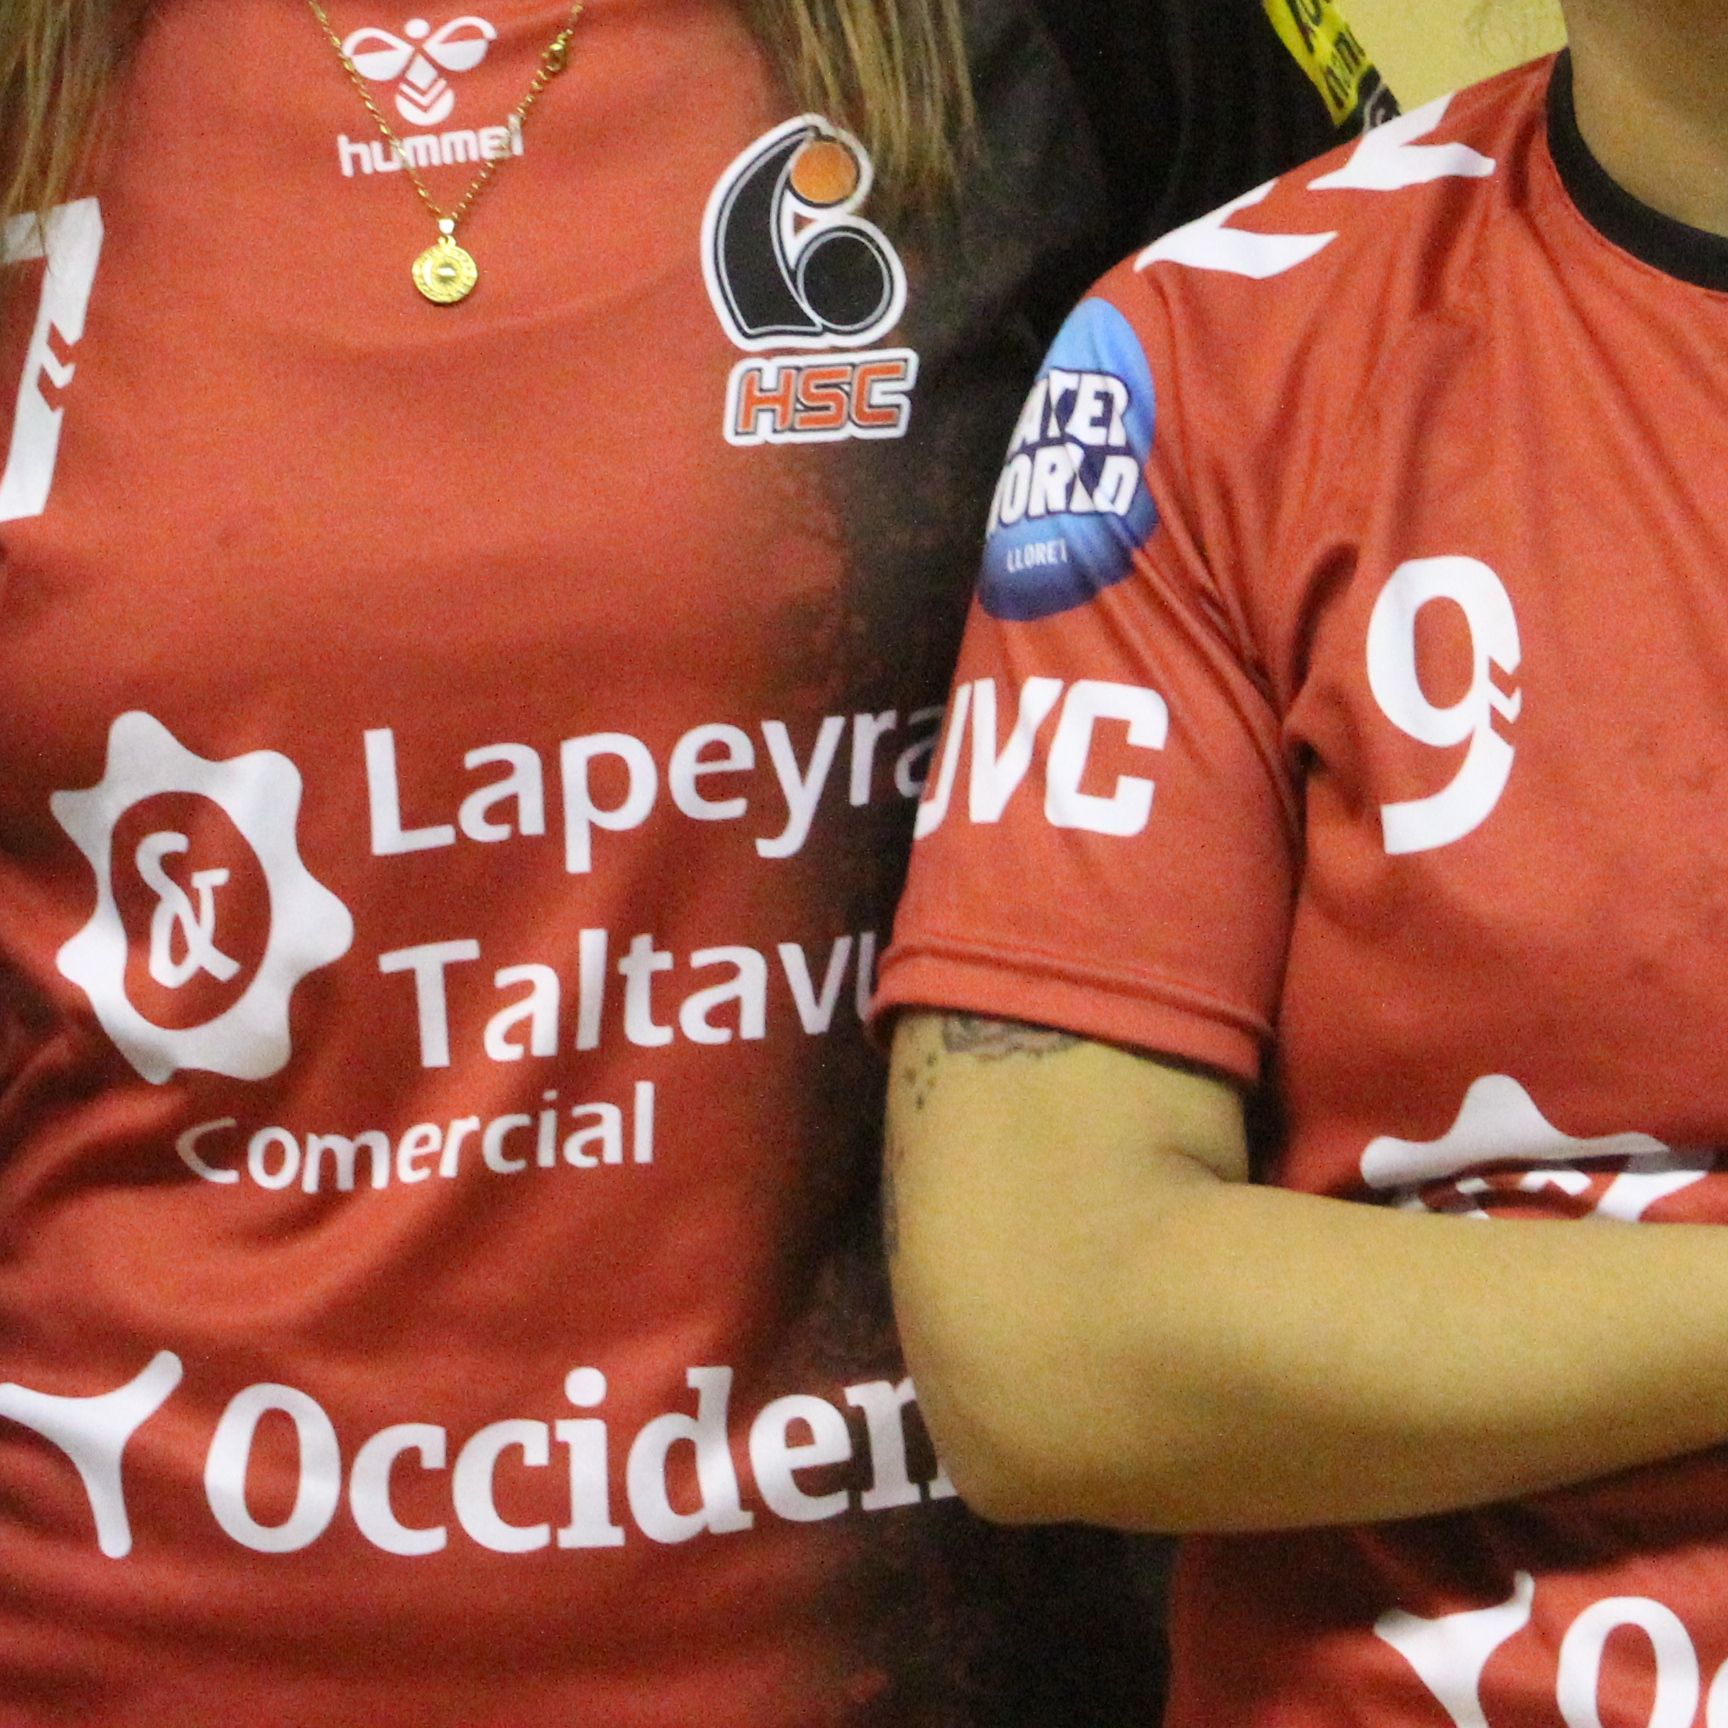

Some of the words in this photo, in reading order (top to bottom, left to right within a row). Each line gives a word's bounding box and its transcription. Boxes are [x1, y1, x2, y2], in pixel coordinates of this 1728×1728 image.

[338, 111, 524, 178] hummel
[734, 360, 912, 432] HSC
[986, 441, 1141, 538] ORLD
[913, 676, 1169, 838] JVC
[1366, 555, 1522, 855] 9
[175, 1080, 656, 1194] Comercial
